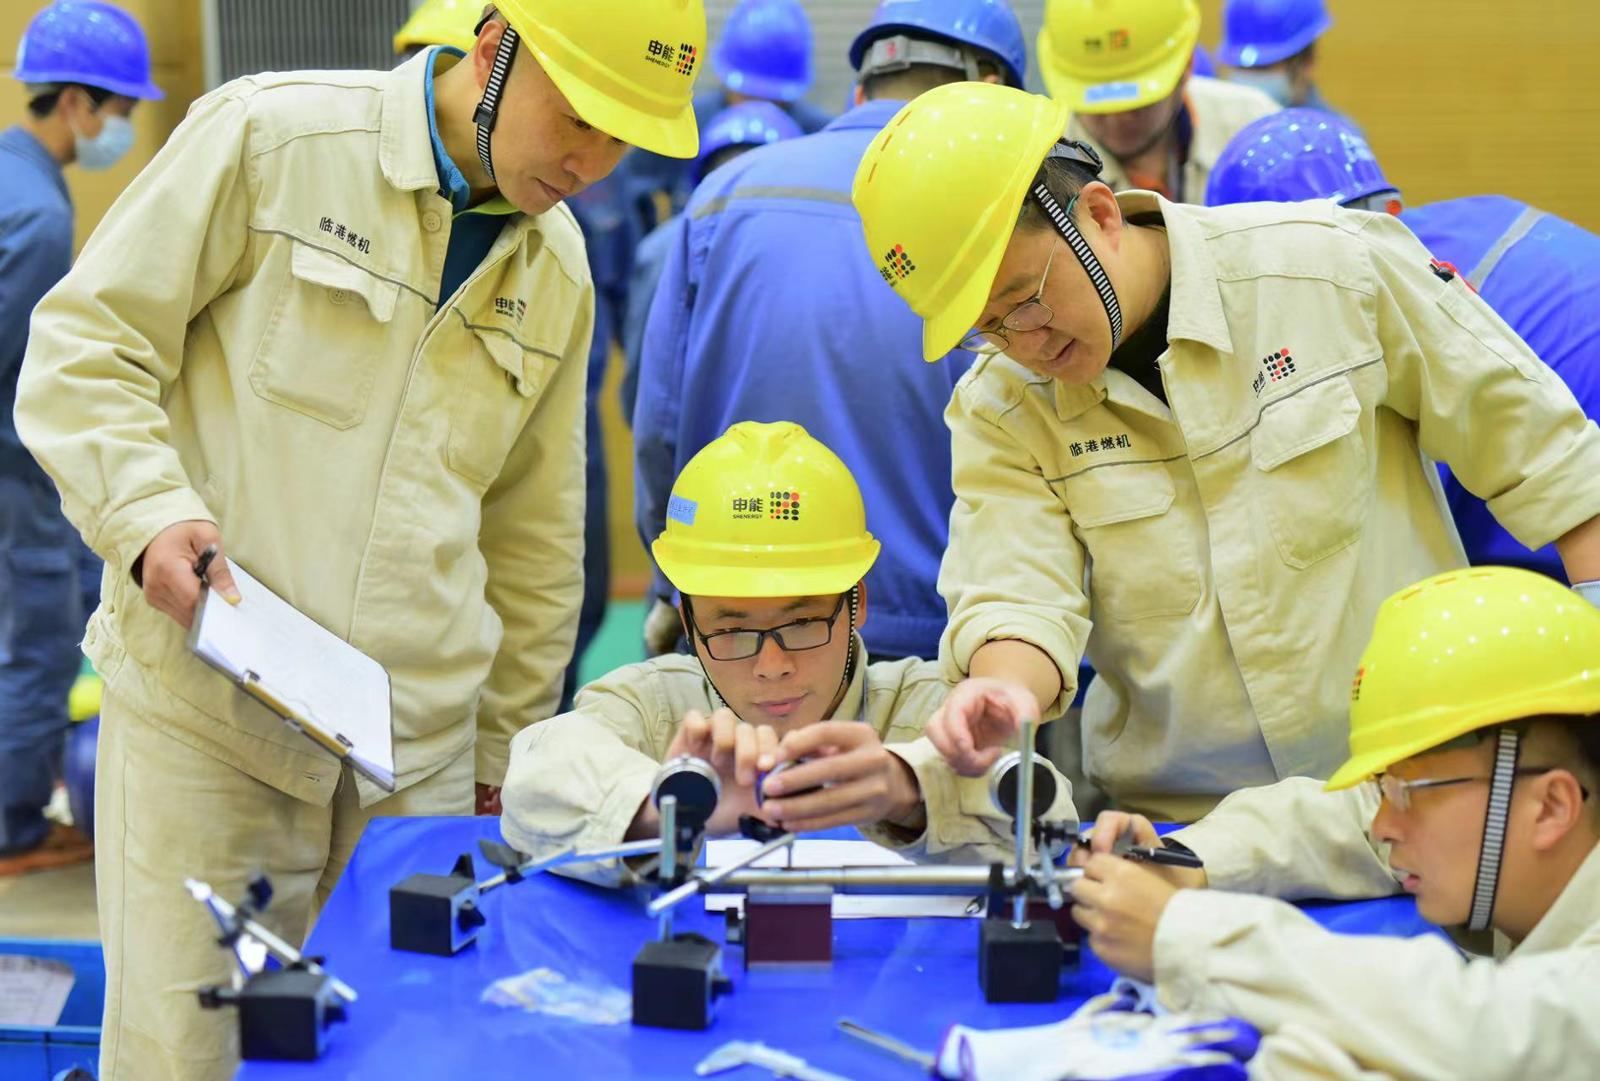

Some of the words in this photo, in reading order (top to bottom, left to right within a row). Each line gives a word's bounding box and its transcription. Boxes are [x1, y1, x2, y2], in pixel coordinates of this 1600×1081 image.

[645, 55, 670, 68] SHENERGY
[648, 40, 675, 62] 申能
[319, 216, 370, 254] 临港燃机
[1069, 433, 1131, 457] 临港燃机
[732, 498, 763, 512] 申能
